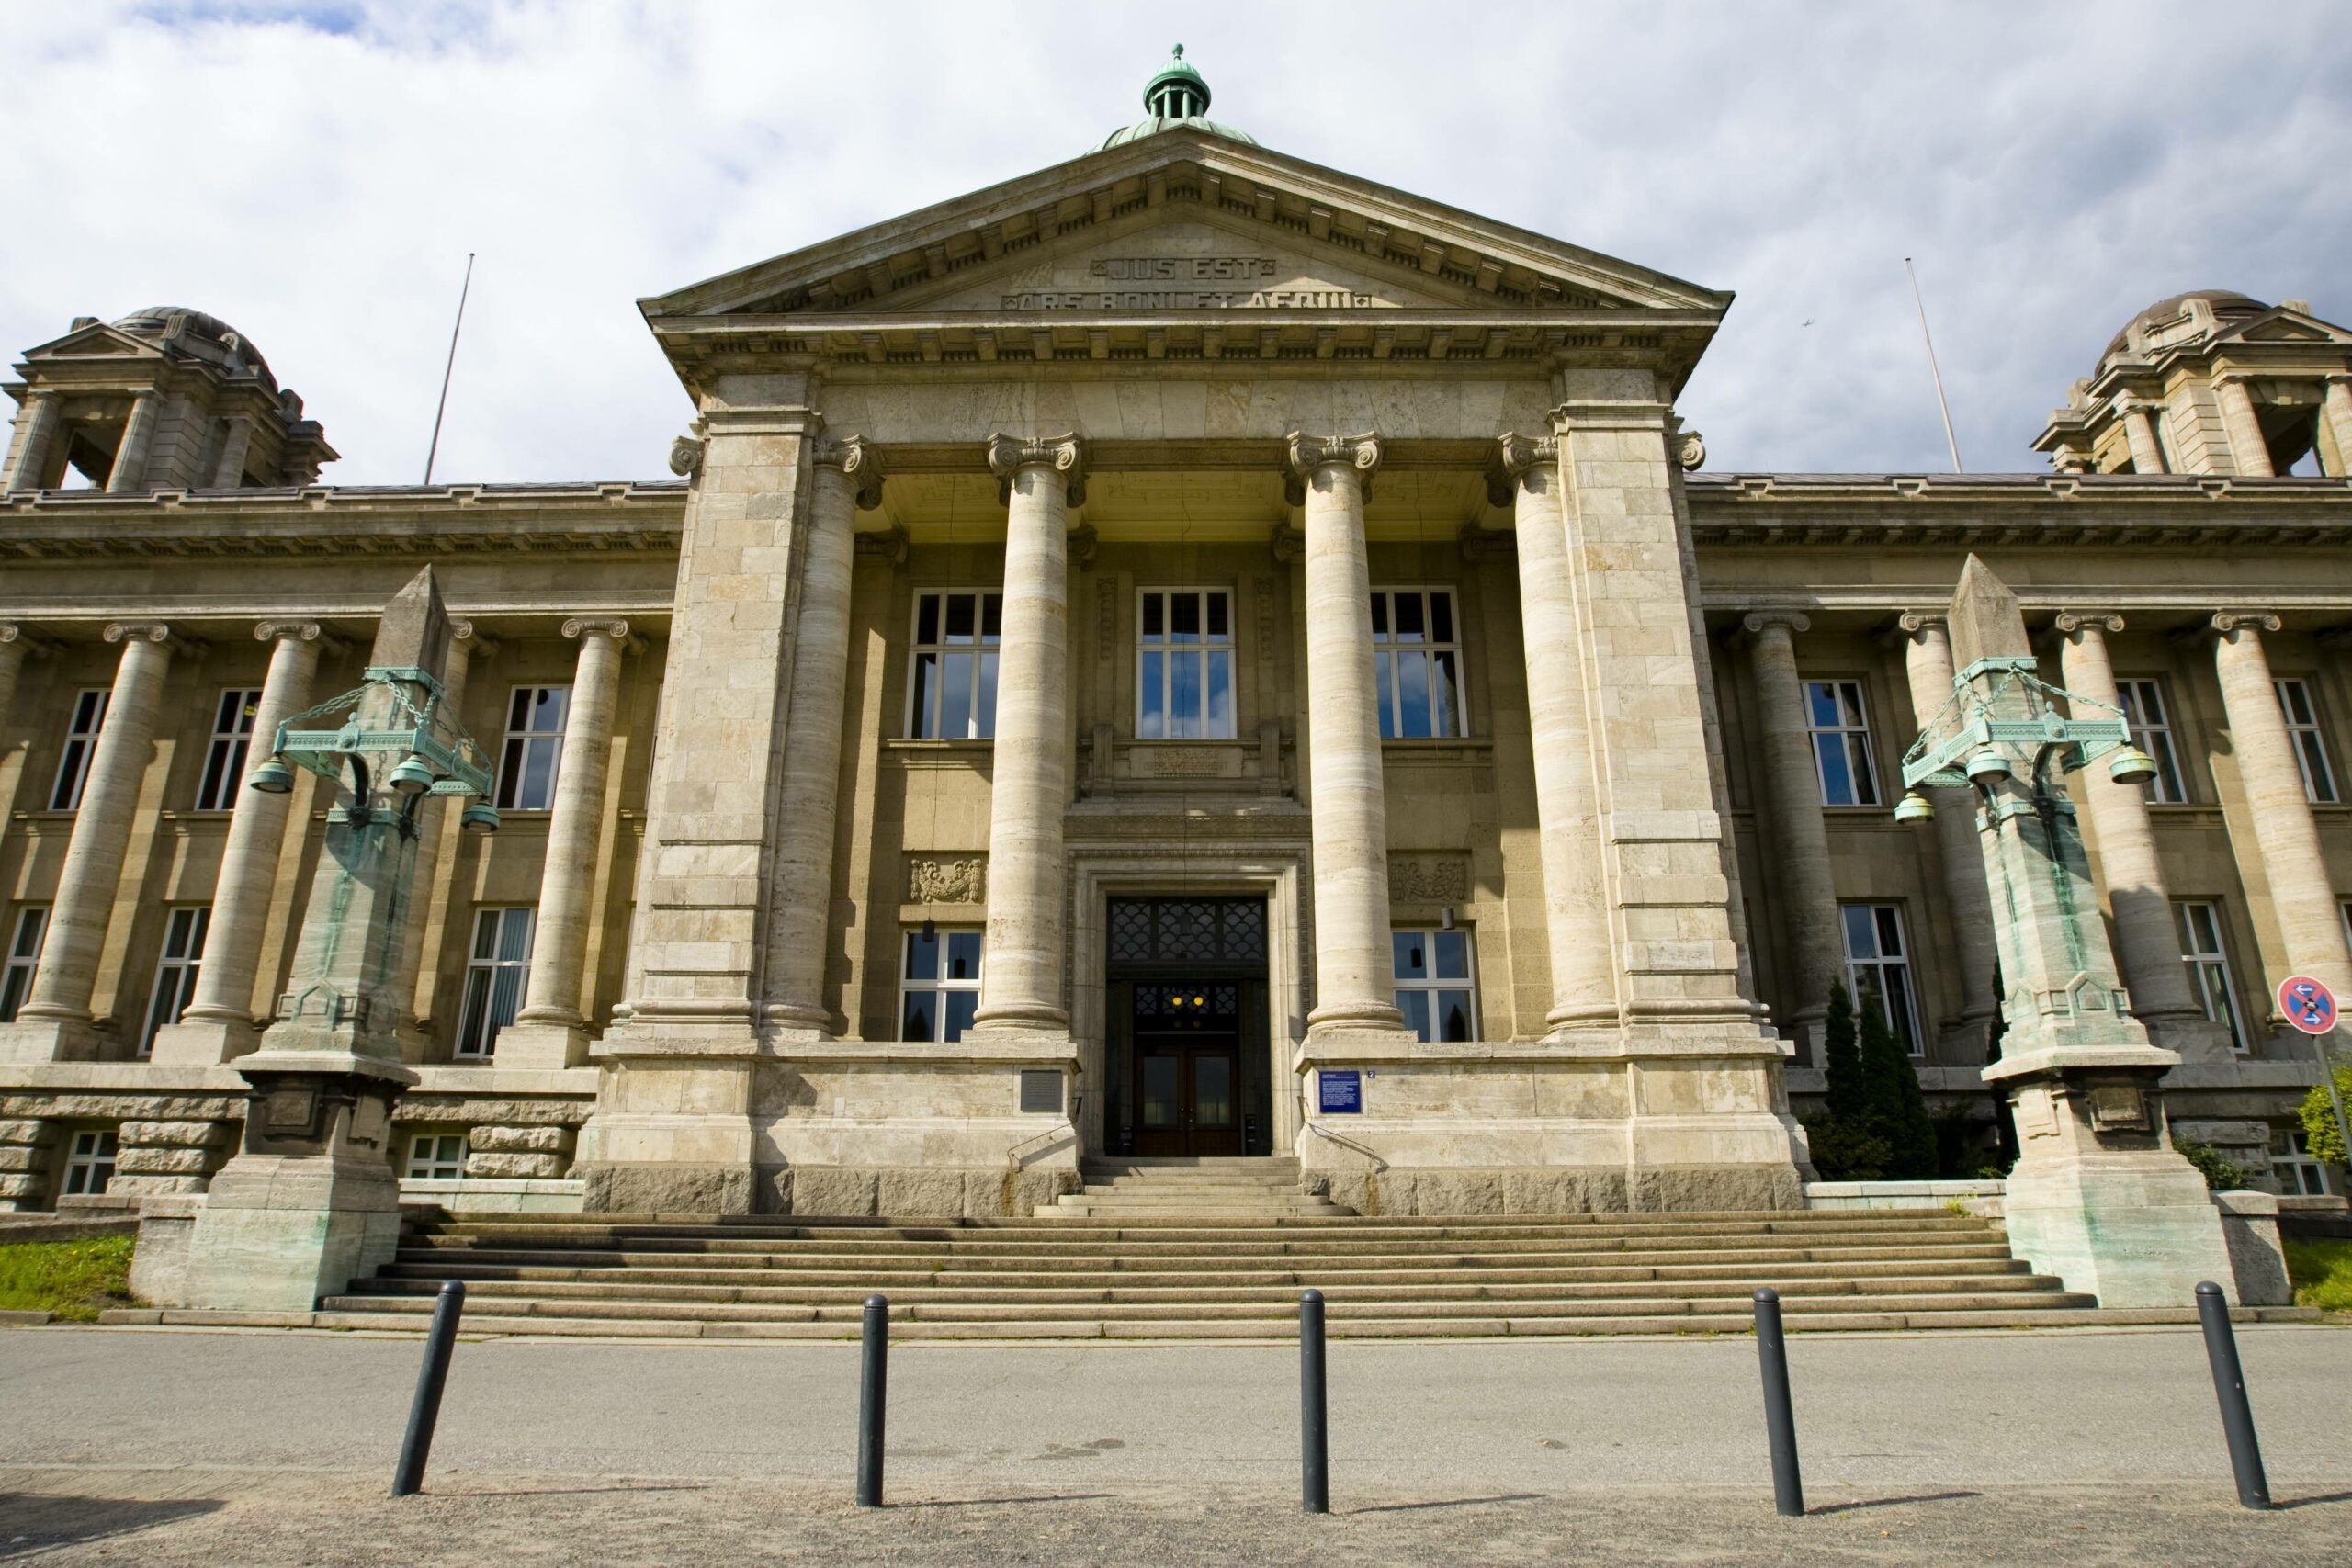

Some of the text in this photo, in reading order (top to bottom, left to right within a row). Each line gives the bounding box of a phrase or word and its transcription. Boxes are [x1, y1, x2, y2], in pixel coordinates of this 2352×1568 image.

[1110, 259, 1257, 280] JUS EST
[1019, 293, 1083, 310] ARS
[1100, 292, 1176, 309] BONI
[1193, 292, 1233, 308] ET
